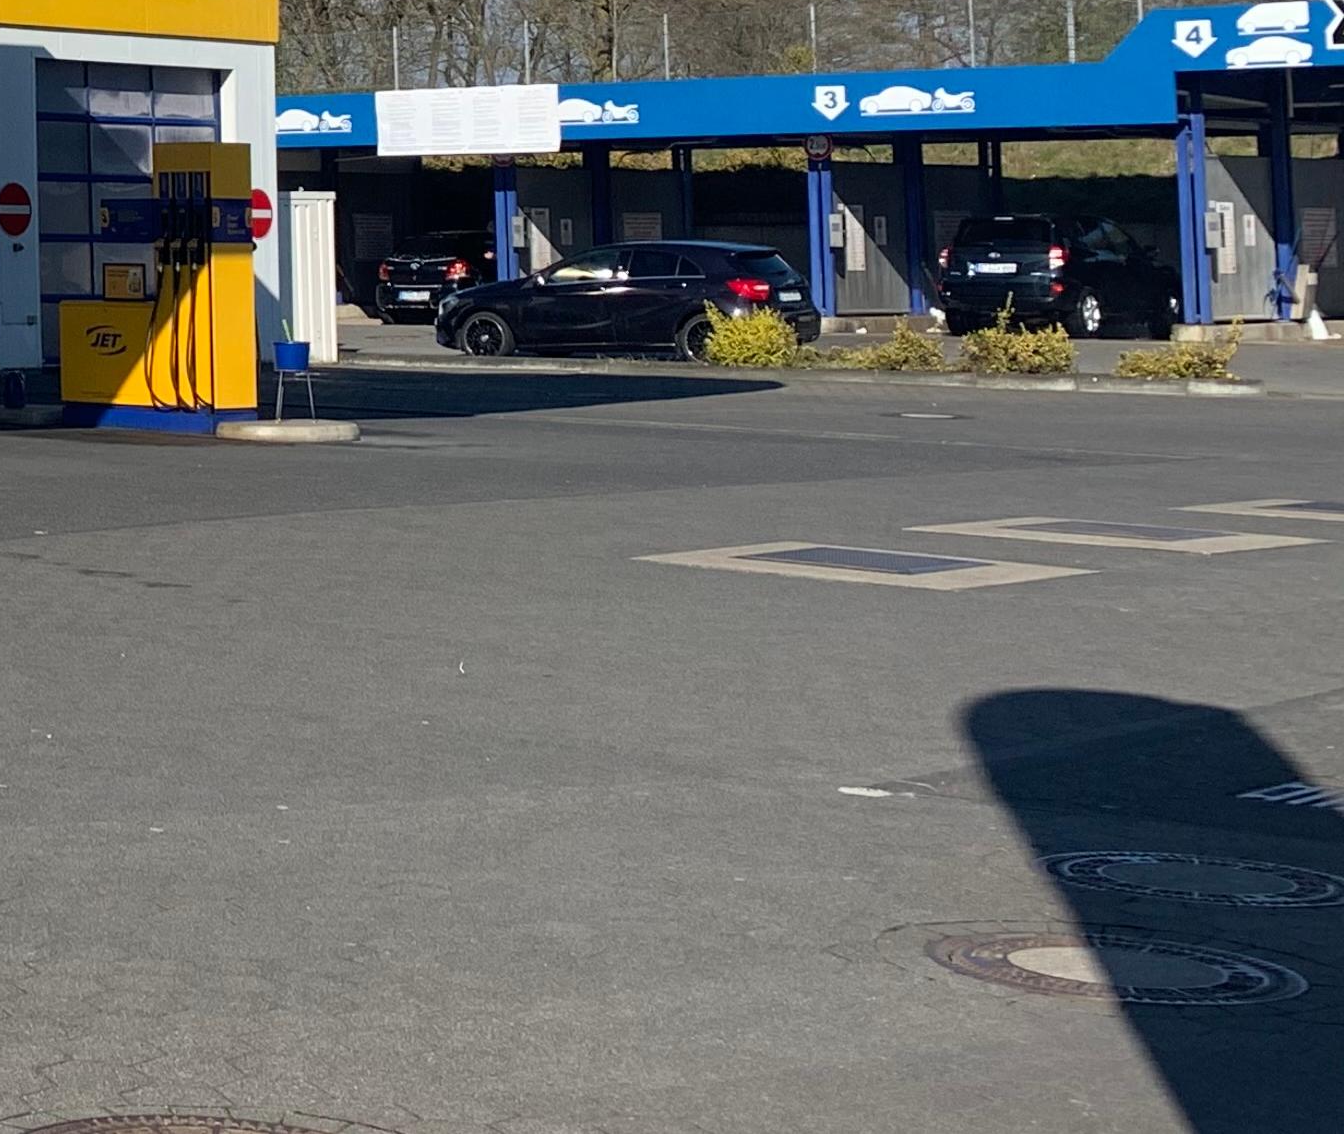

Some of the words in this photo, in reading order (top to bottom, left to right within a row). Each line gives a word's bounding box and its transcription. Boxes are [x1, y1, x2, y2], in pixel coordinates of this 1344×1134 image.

[1185, 25, 1204, 45] 4
[824, 91, 838, 109] 3
[91, 332, 123, 348] JET
